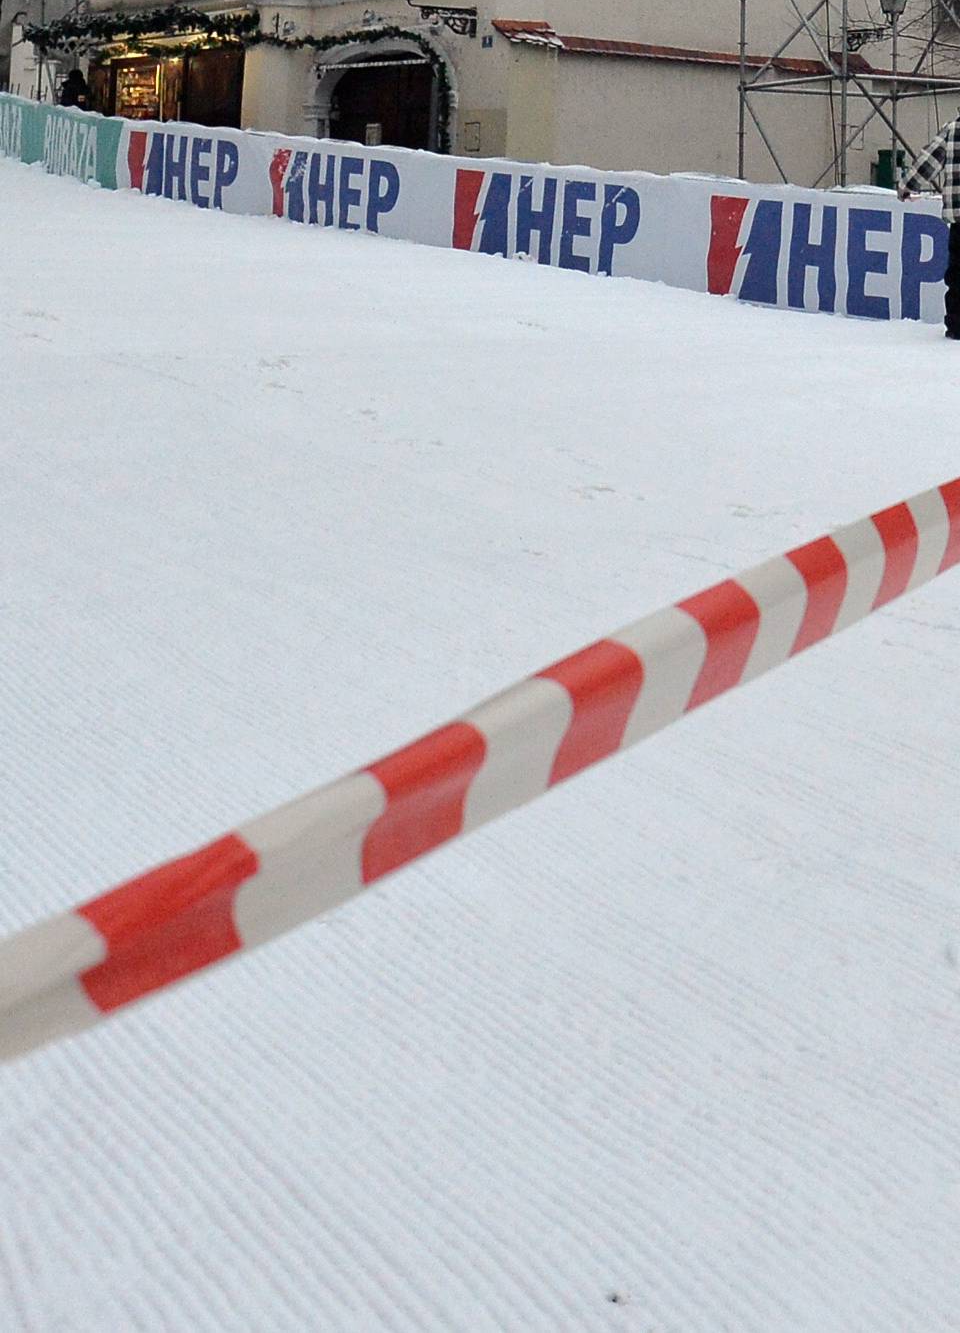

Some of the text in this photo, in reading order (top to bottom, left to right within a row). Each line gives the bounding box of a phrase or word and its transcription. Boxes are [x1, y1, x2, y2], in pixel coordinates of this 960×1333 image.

[164, 134, 239, 210] HEP
[308, 152, 400, 233] HEP
[516, 176, 640, 275] HEP
[787, 203, 949, 320] HEP
